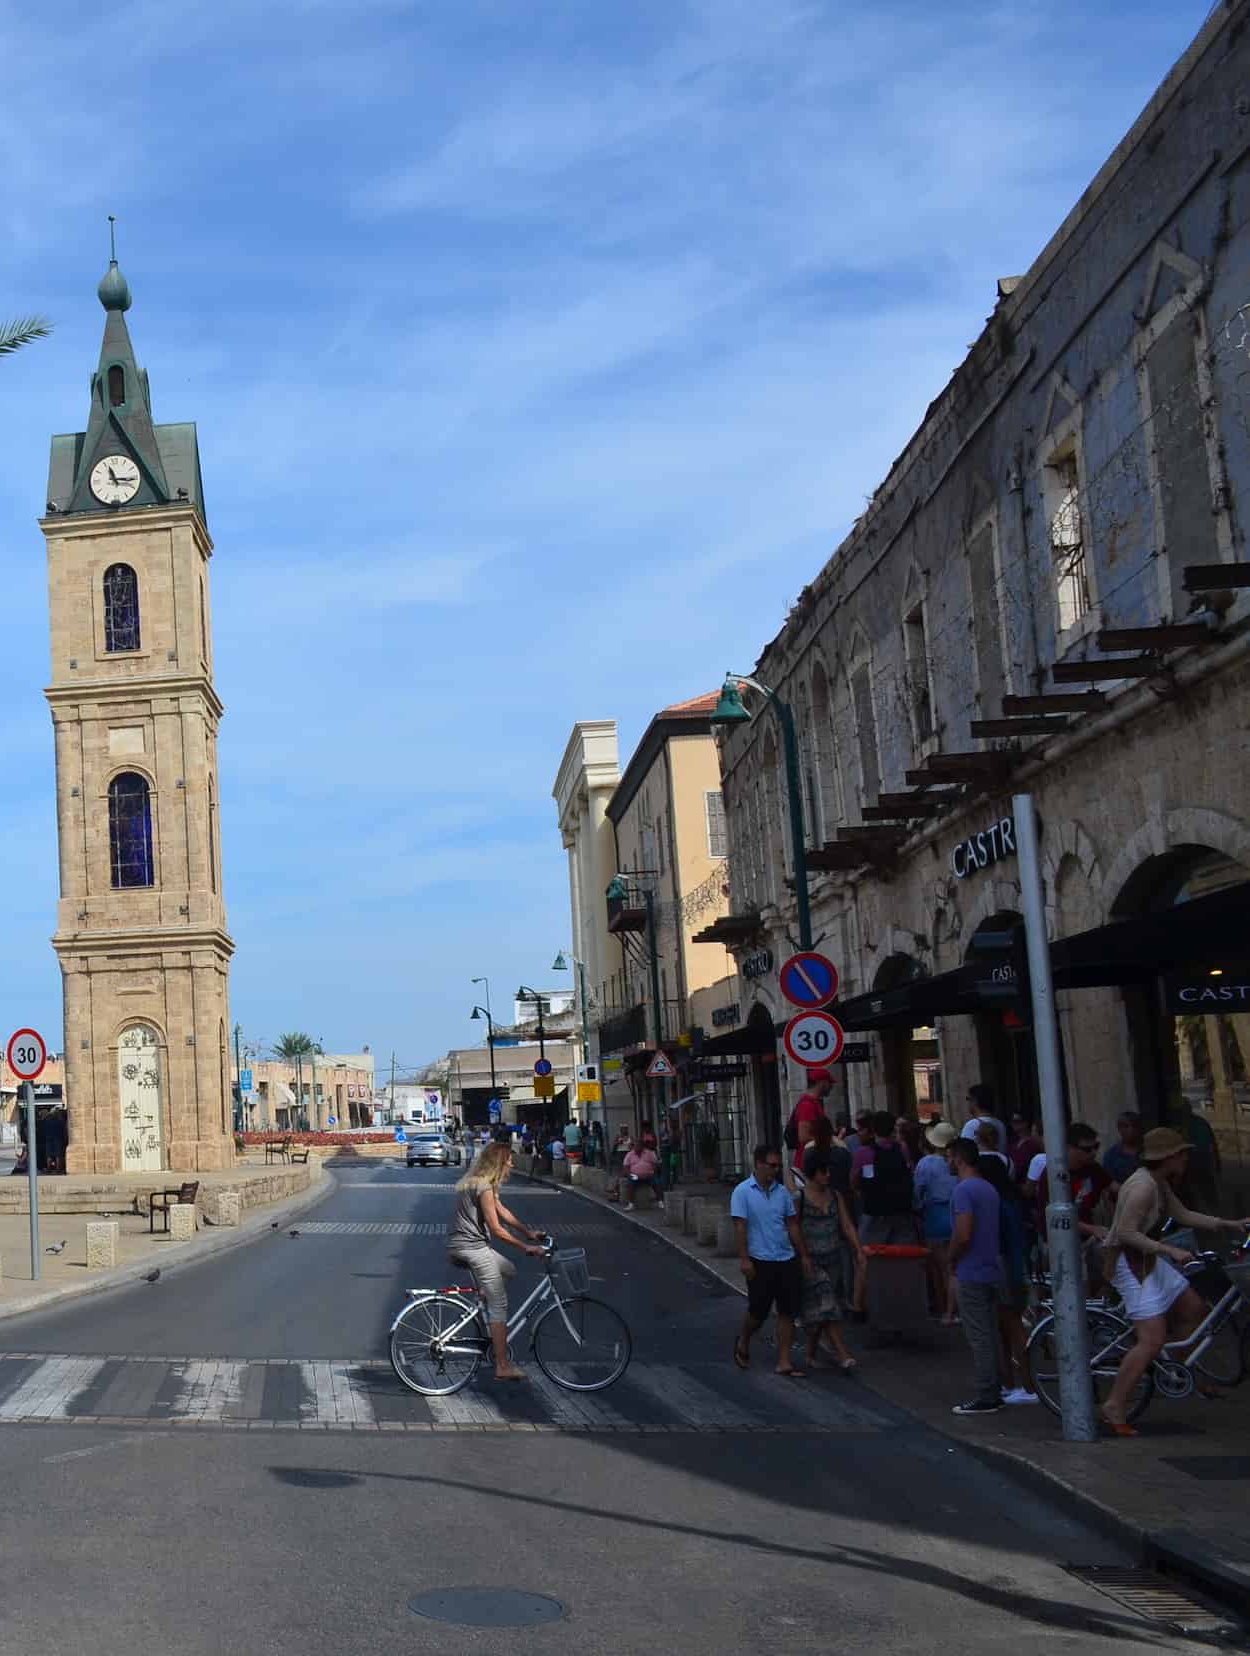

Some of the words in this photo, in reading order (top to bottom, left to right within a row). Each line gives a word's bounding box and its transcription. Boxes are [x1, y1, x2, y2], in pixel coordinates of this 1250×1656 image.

[952, 817, 1016, 878] CASTR
[797, 1030, 830, 1051] 30
[17, 1047, 37, 1064] 30
